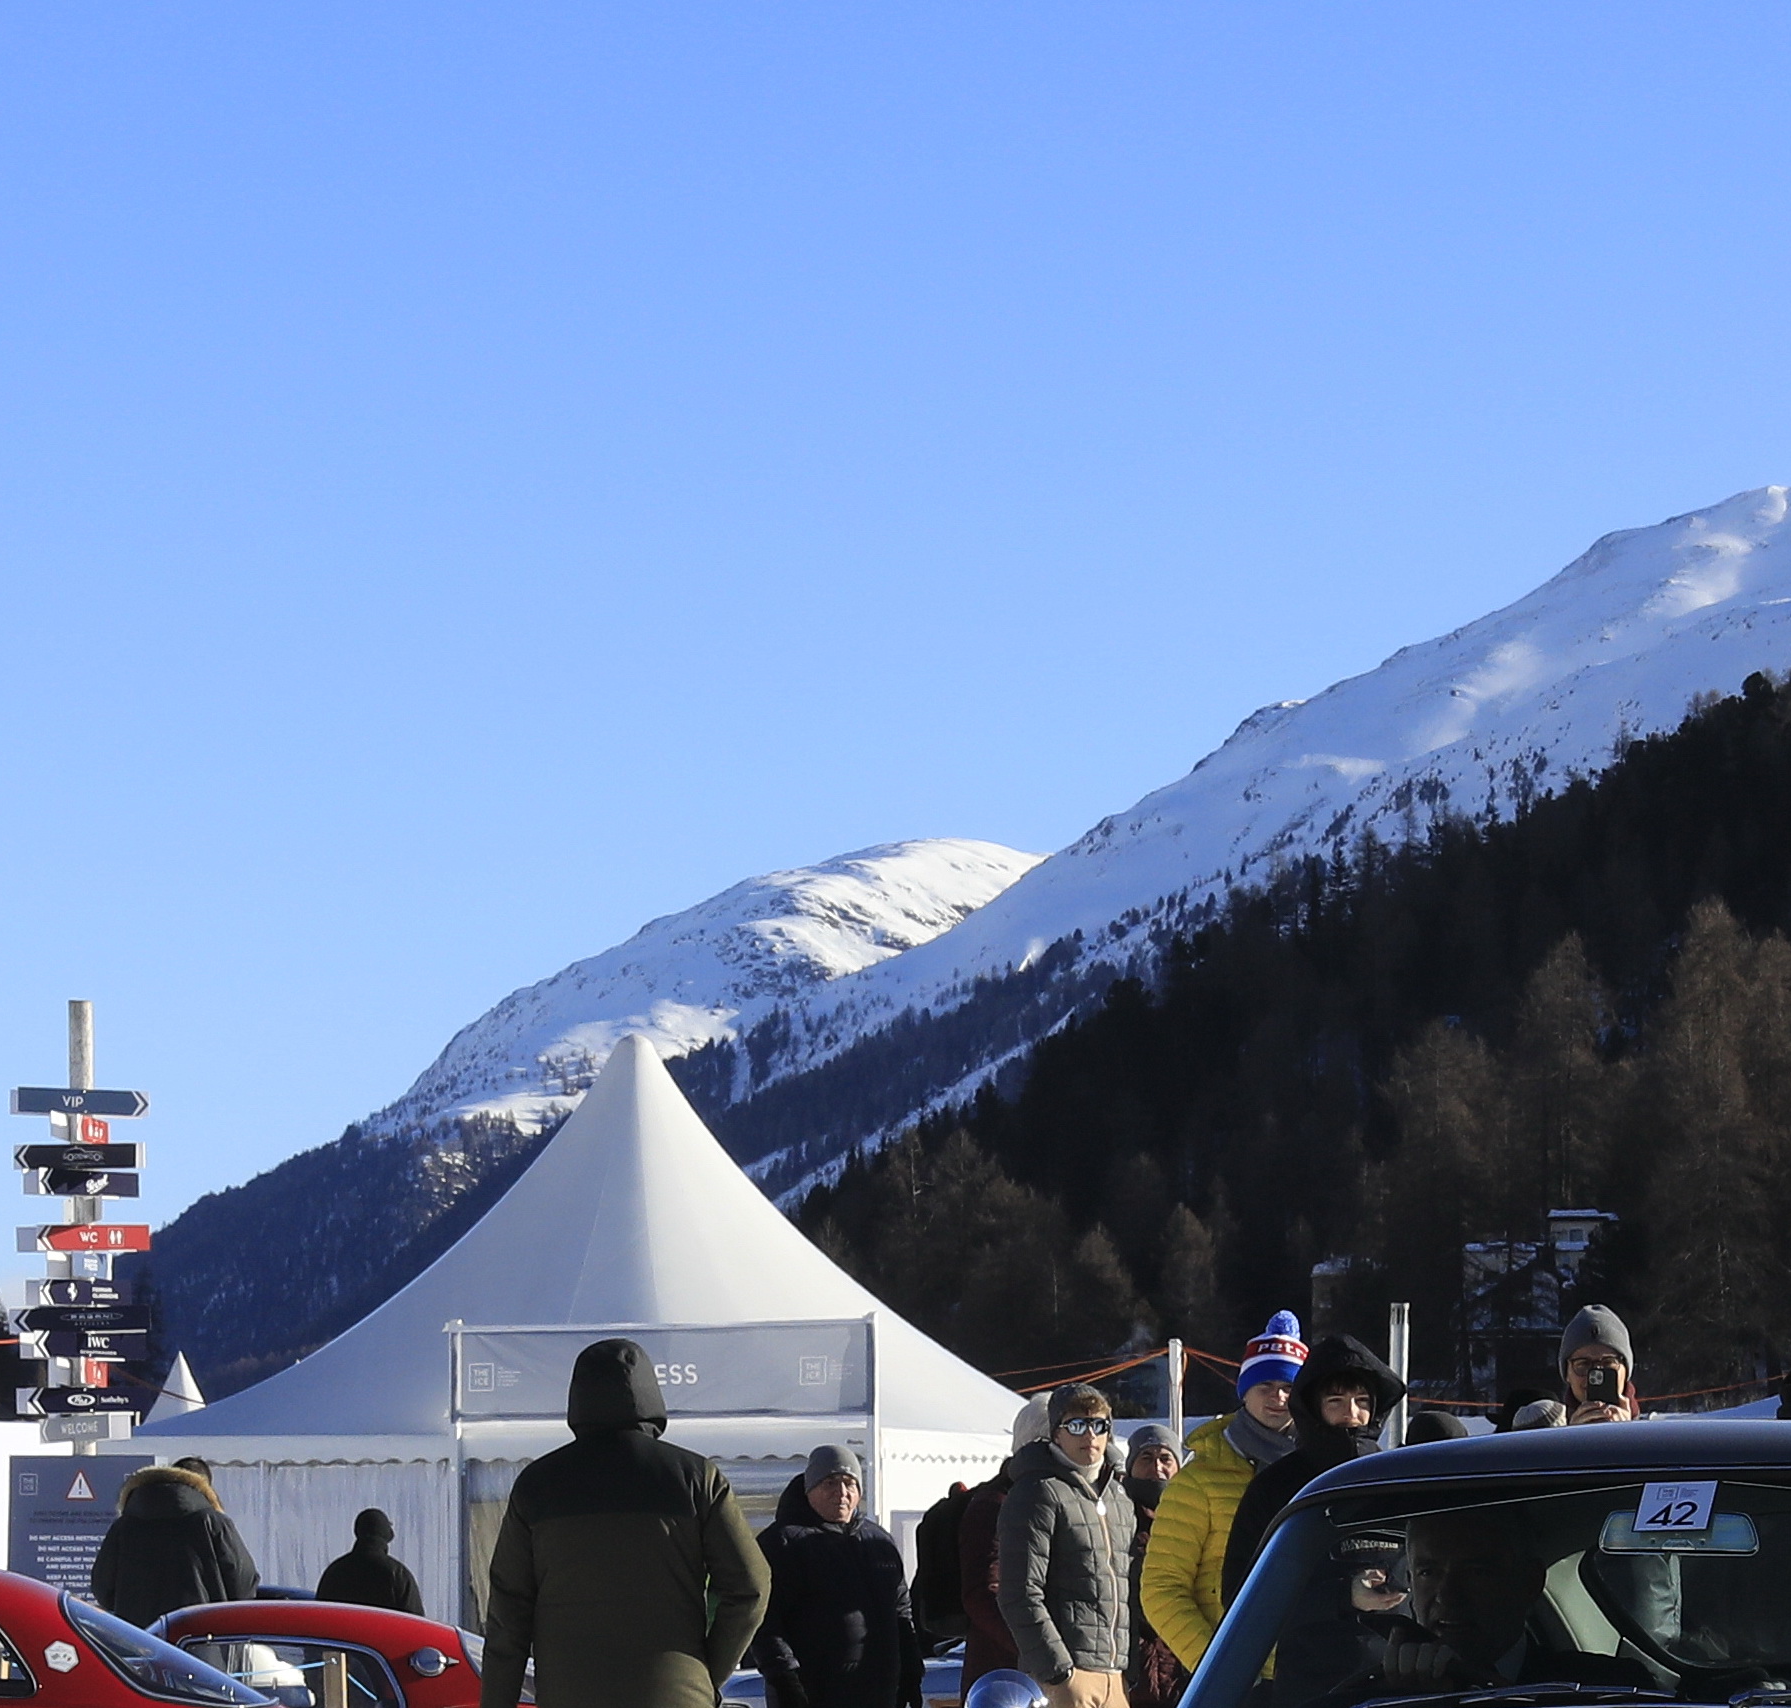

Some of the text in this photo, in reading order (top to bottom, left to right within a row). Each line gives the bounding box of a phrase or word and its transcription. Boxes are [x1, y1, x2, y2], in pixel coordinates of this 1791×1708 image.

[62, 1095, 84, 1107] VIP
[79, 1231, 98, 1243] WC
[654, 1363, 699, 1385] ESS
[60, 1421, 98, 1435] WELCOME
[1645, 1501, 1699, 1526] 42
